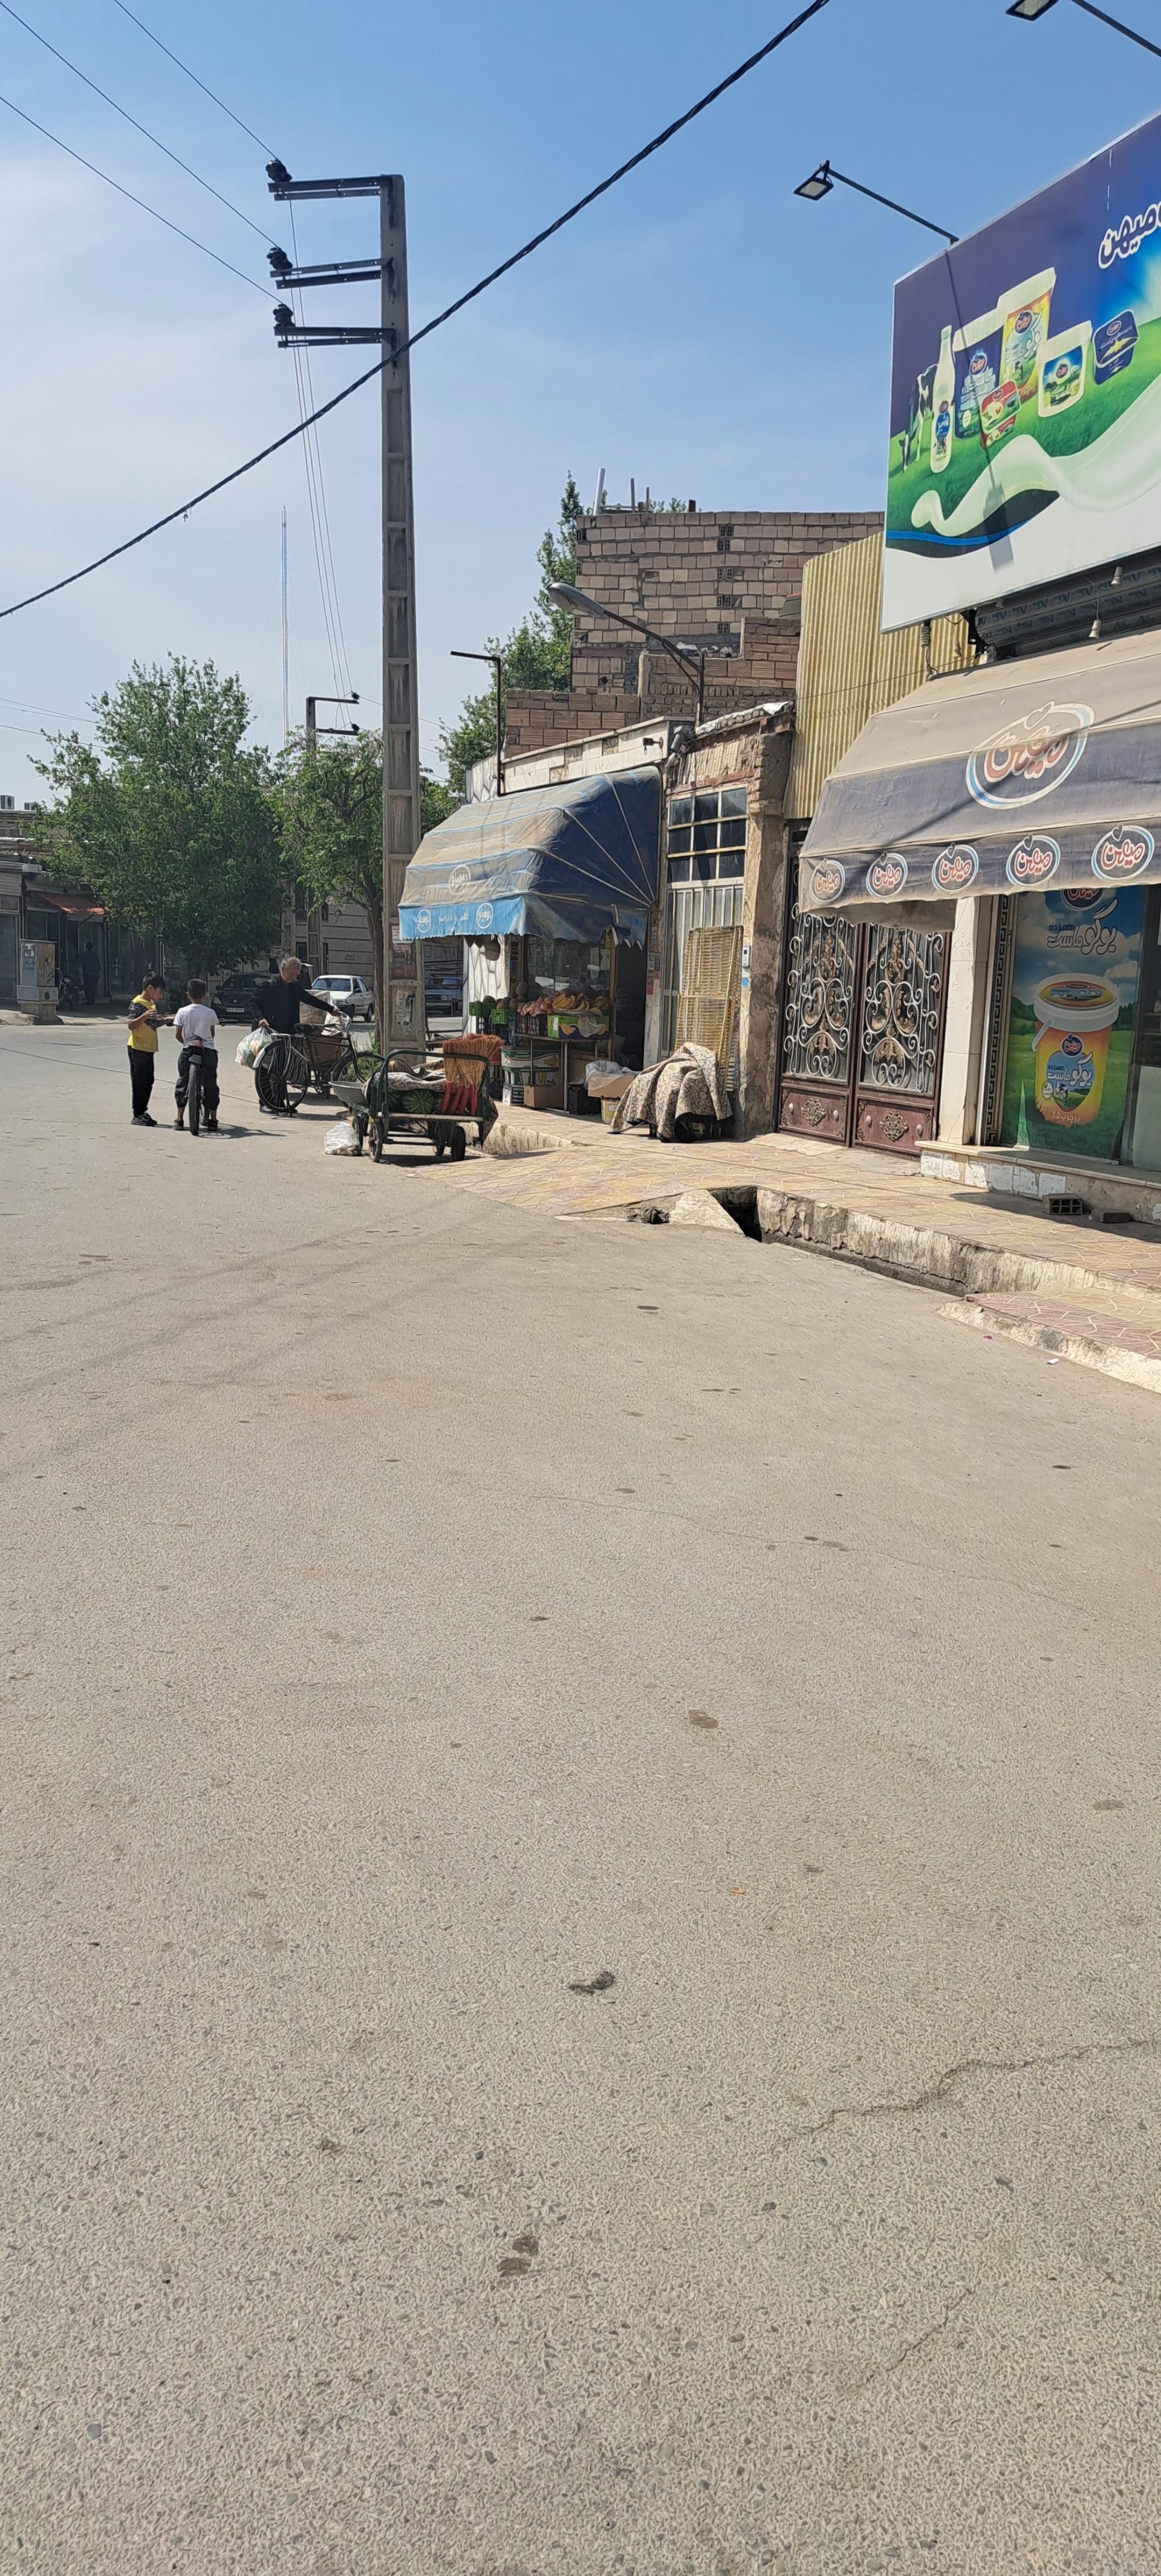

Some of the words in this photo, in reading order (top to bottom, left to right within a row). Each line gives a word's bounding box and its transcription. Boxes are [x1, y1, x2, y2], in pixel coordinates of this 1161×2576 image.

[1098, 203, 1157, 269] میهن
[984, 725, 1070, 783] میهن
[938, 856, 972, 883] میهن
[1014, 847, 1053, 877] میهن
[1101, 839, 1145, 870] میهن
[815, 870, 840, 894] میهن
[872, 864, 902, 889] میهن
